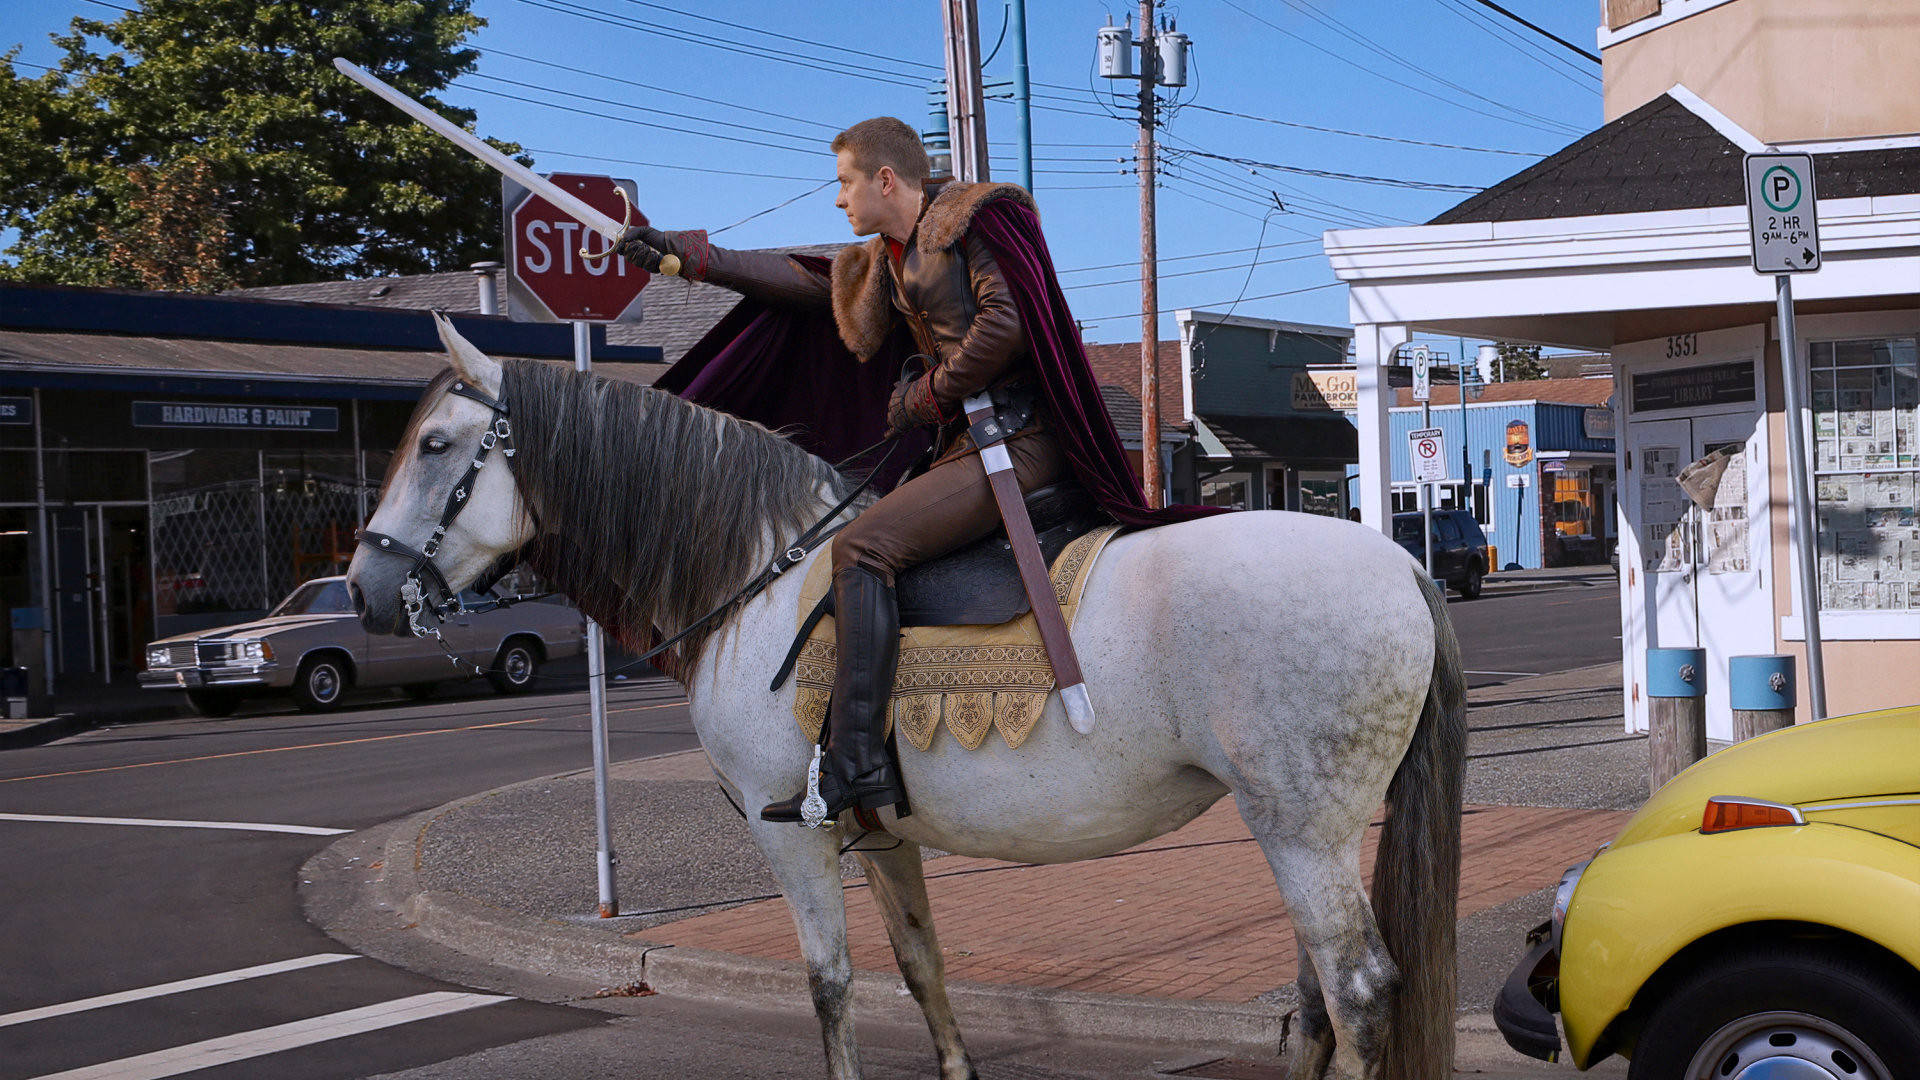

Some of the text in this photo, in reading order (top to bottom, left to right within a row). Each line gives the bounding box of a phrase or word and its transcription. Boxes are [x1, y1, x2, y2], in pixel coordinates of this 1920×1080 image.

[1773, 176, 1790, 202] P
[1768, 215, 1801, 230] 2 HR
[524, 219, 626, 277] STO
[1666, 335, 1698, 359] 3551
[1294, 392, 1358, 401] PAWNBROK
[1673, 382, 1714, 403] LIBRARY
[162, 405, 312, 426] HARDWARE & PAINT
[1411, 430, 1441, 439] TEMPORARY
